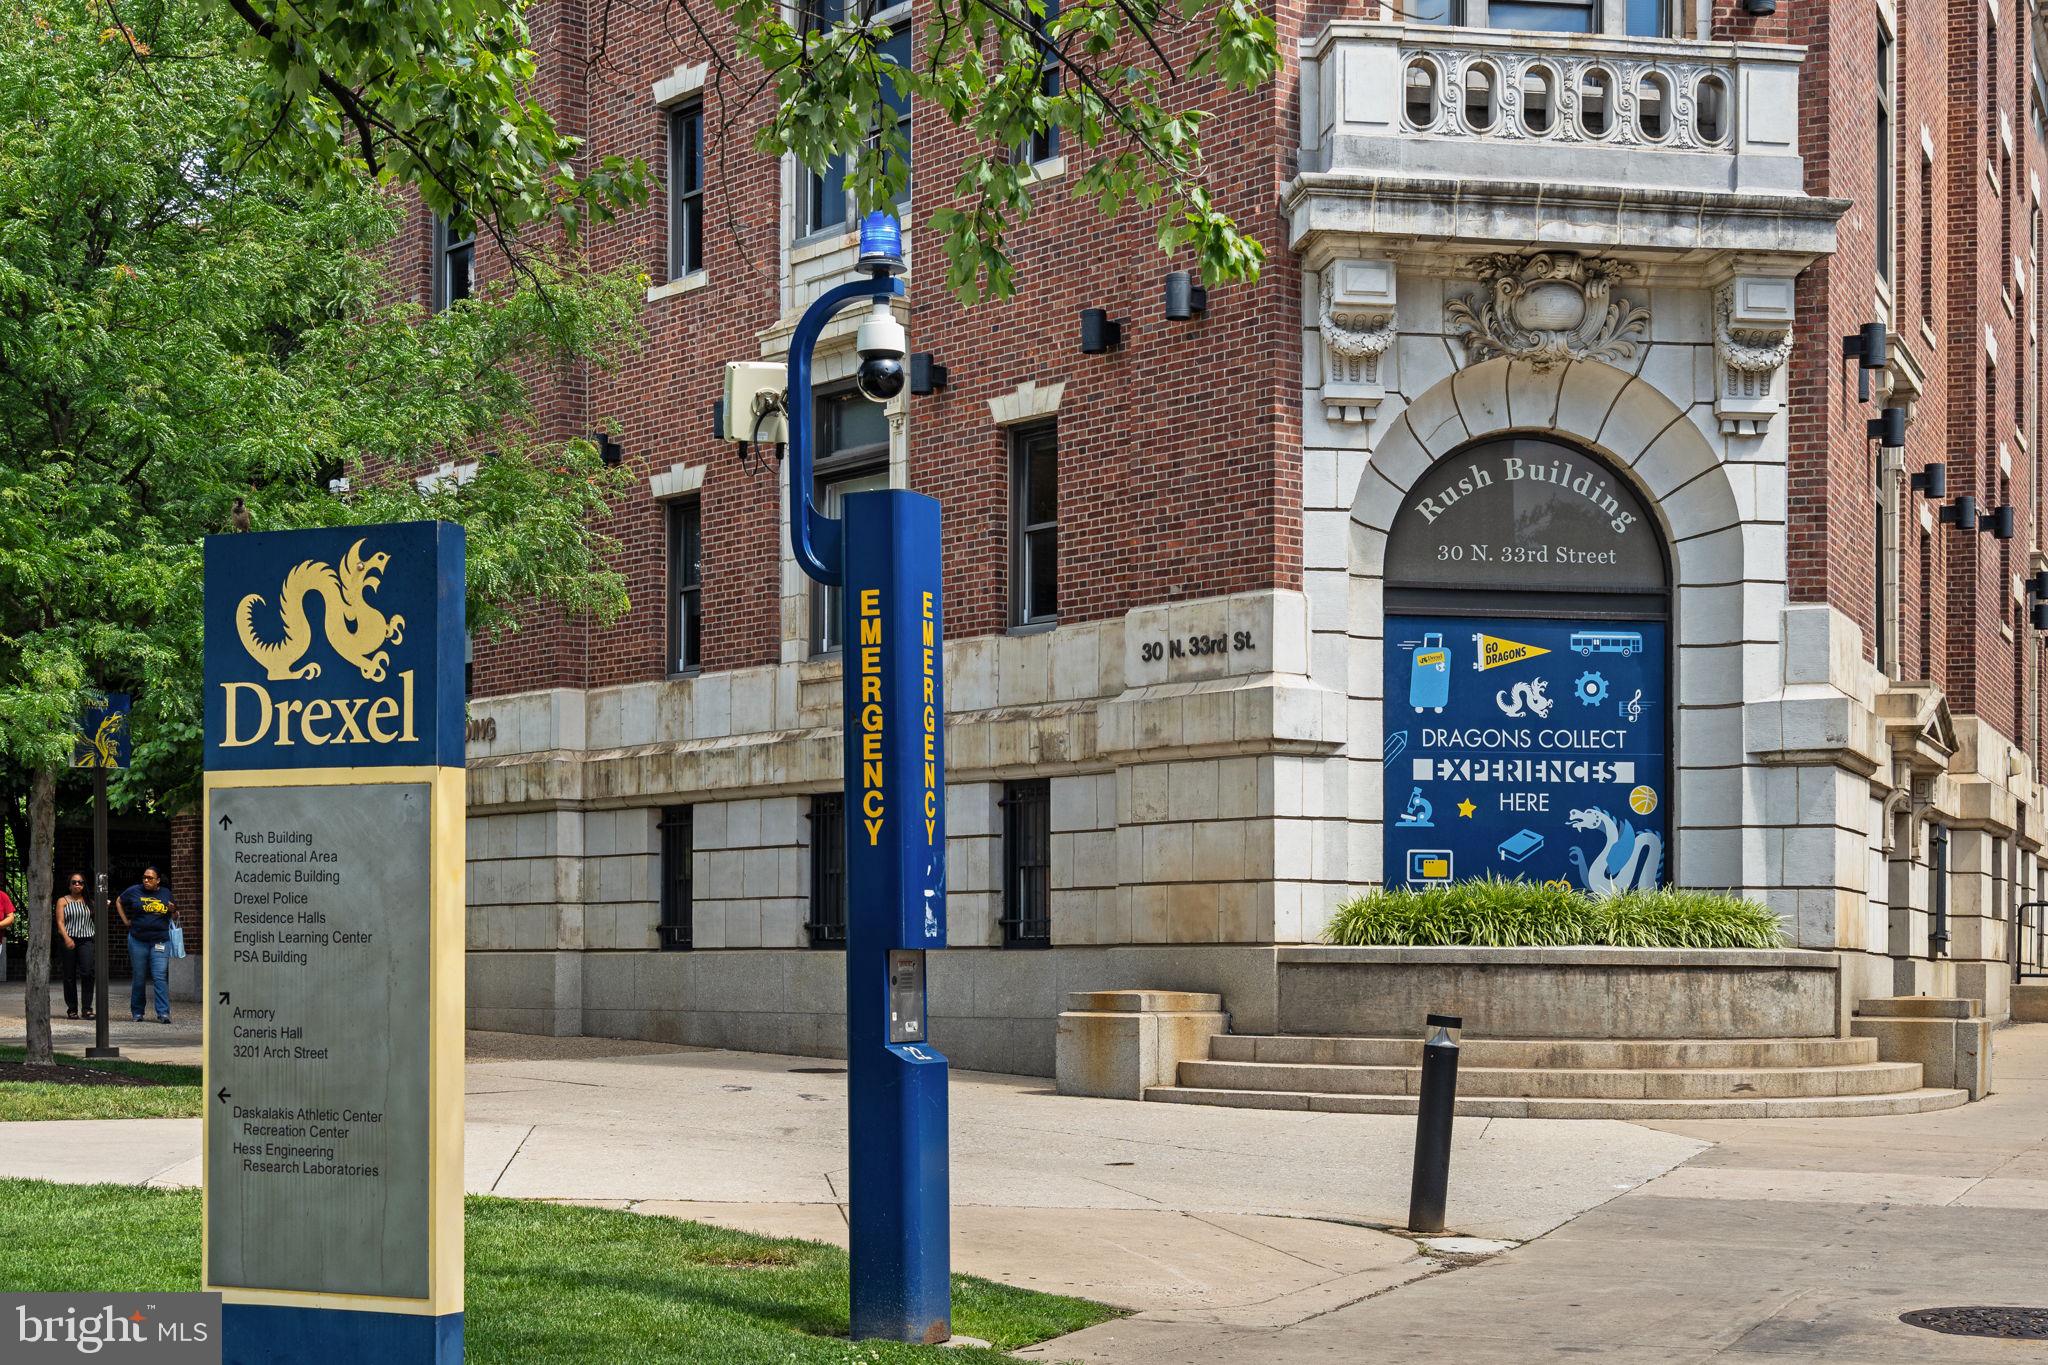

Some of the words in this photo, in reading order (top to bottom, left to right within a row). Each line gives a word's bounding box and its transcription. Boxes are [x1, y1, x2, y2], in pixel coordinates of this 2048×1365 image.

[1414, 464, 1494, 525] Rush
[1502, 457, 1637, 534] Building
[1437, 545, 1463, 561] 30
[1470, 544, 1493, 562] N.
[1500, 545, 1549, 563] 33rd
[1556, 546, 1617, 564] Street
[1141, 642, 1164, 662] 30
[1169, 639, 1186, 659] N.
[1188, 633, 1228, 656] 33rd
[1233, 631, 1256, 651] St.
[1486, 642, 1498, 653] GO
[1486, 646, 1527, 665] DRAGONS
[219, 670, 419, 747] Drexel
[860, 589, 884, 846] EMERGENCY
[922, 591, 936, 846] EMERGENCY
[1422, 728, 1531, 748] DRAGONS
[1538, 729, 1627, 749] COLLECT
[1435, 758, 1618, 783] EXPERIENCES
[1500, 793, 1550, 812] HERE
[235, 831, 264, 844] Rush
[268, 831, 313, 846] Building
[235, 851, 307, 864] Recreational
[310, 851, 338, 863] Area
[235, 870, 291, 883] Academic
[294, 870, 340, 885] Building
[234, 892, 270, 905] Drexel
[273, 892, 308, 905] Police
[234, 911, 294, 924] Residence
[298, 911, 326, 924] Halls
[234, 931, 275, 946] English
[278, 931, 329, 946] Learning
[332, 931, 372, 943] Center
[234, 951, 259, 963] PSA
[262, 951, 307, 966] Building
[233, 1007, 275, 1022] Armory
[233, 1026, 277, 1039] Caneris
[281, 1027, 303, 1039] Hall
[233, 1046, 260, 1058] 3201
[263, 1046, 291, 1058] Arch
[294, 1047, 328, 1059] Street
[233, 1106, 294, 1120] Daskalakis
[297, 1108, 340, 1122] Athletic
[342, 1109, 383, 1123] Center
[243, 1123, 306, 1137] Recreation
[309, 1125, 349, 1138] Center
[233, 1142, 262, 1155] Hess
[266, 1143, 334, 1160] Engineering
[243, 1159, 300, 1174] Research
[303, 1161, 379, 1177] Laboratories
